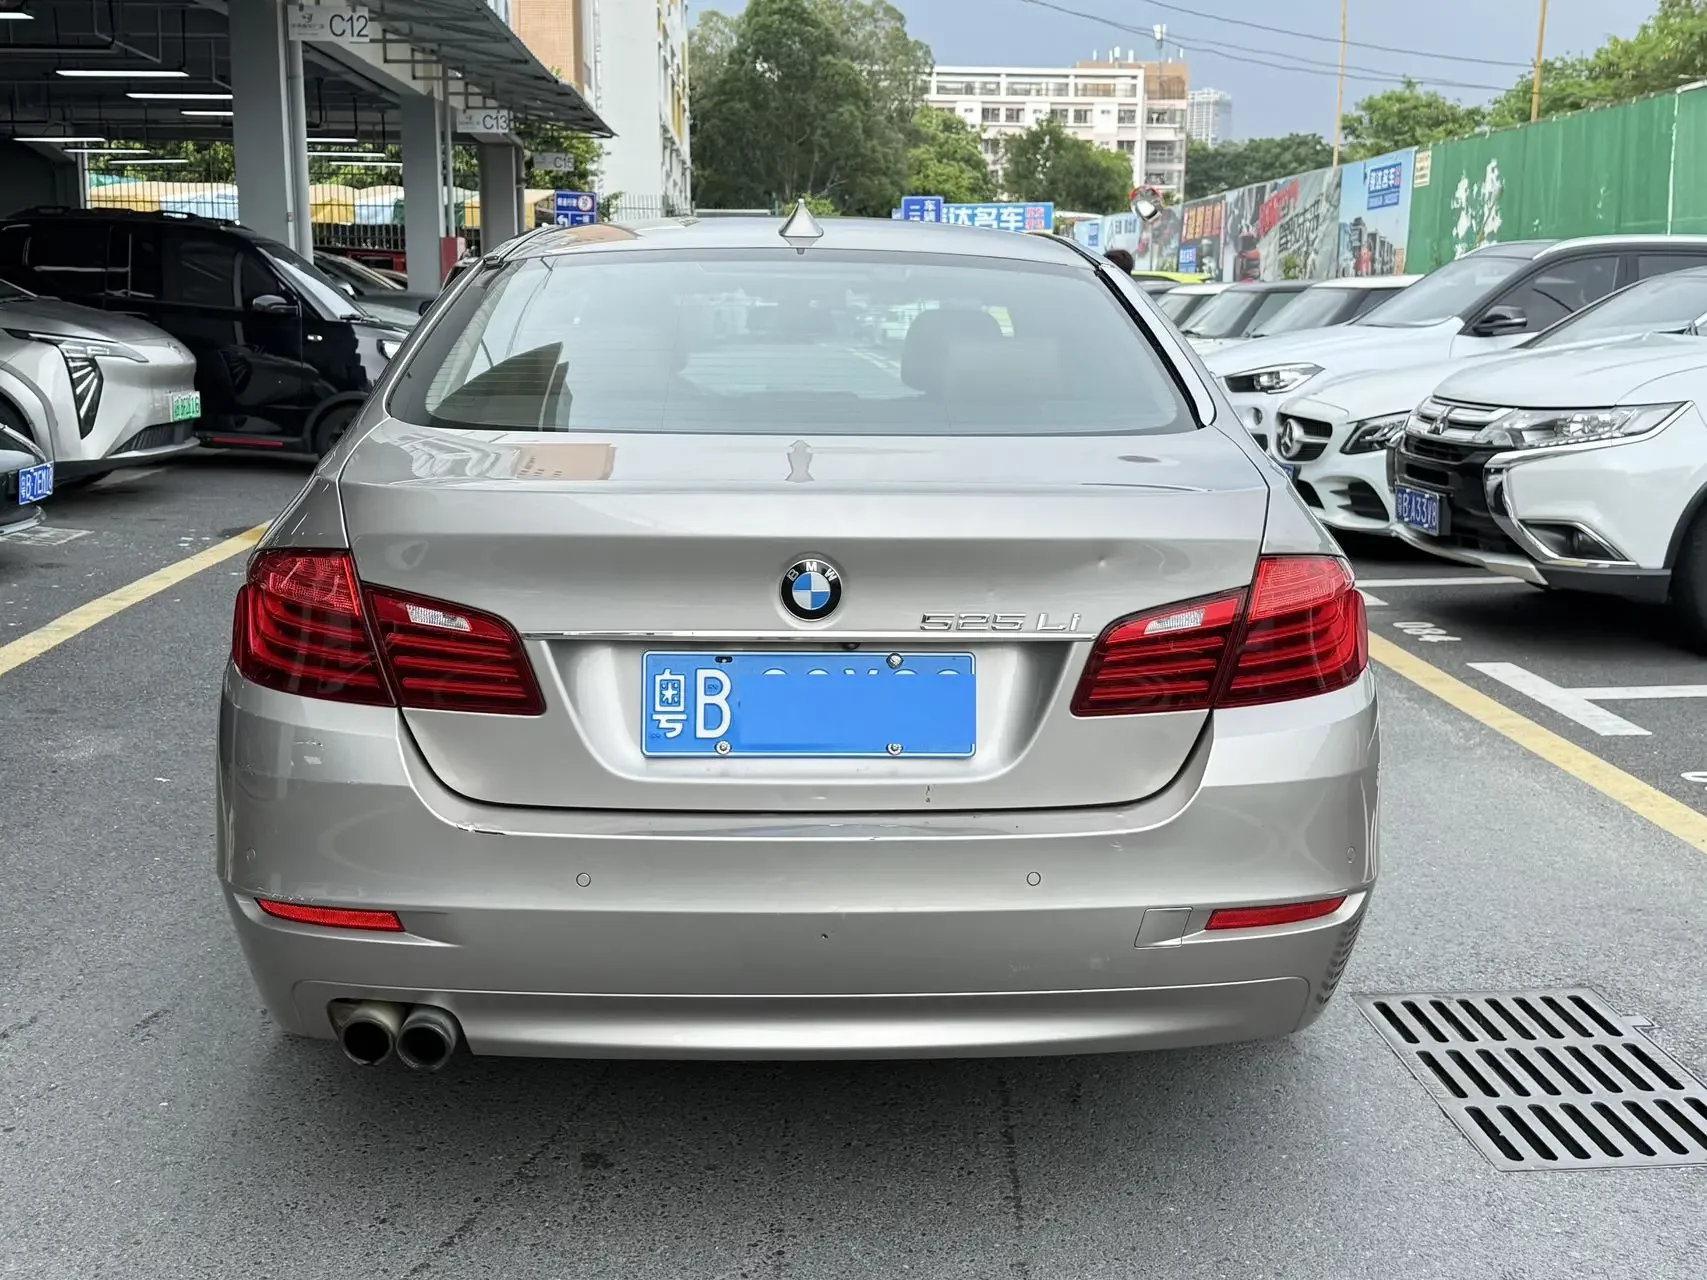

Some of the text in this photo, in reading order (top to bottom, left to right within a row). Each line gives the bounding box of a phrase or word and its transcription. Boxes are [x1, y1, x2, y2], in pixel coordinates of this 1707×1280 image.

[329, 13, 369, 37] C12
[482, 114, 508, 130] C13
[942, 206, 1024, 231] 达名车
[786, 561, 838, 582] BMW
[919, 612, 1027, 631] 525
